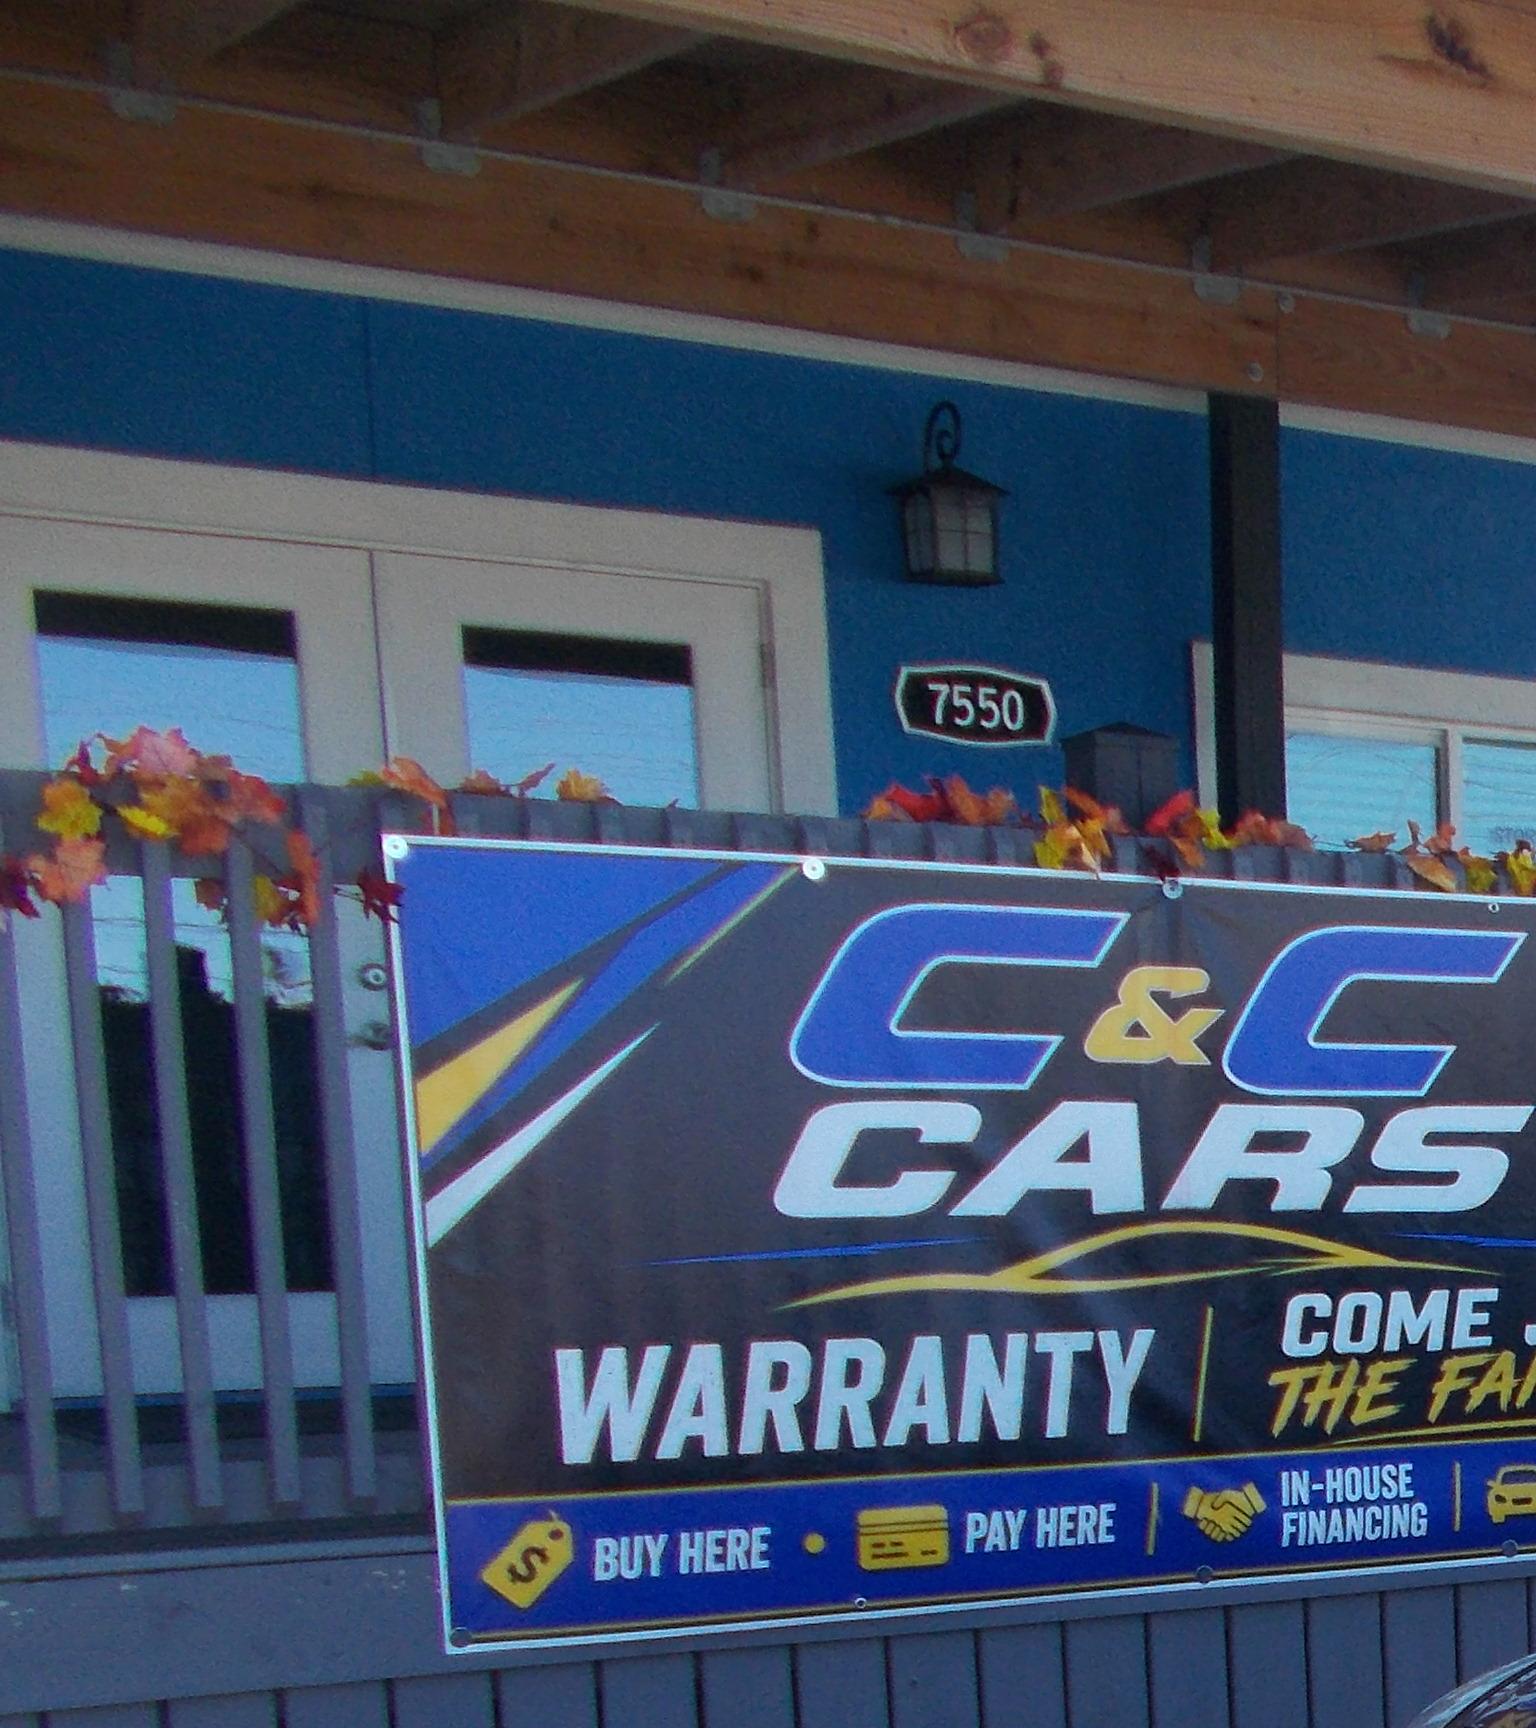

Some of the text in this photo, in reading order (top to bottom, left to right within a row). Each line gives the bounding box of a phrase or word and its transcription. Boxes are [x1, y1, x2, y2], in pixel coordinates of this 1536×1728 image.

[928, 683, 1024, 731] 7550
[773, 1101, 1536, 1218] CARS
[1281, 1288, 1500, 1358] COME
[555, 1328, 1155, 1465] WARRANTY
[1268, 1357, 1418, 1438] THE
[1281, 1463, 1414, 1507] IN-HOUSE
[965, 1503, 1117, 1553] PAY HERE
[1281, 1502, 1428, 1548] FINANCING
[594, 1526, 772, 1581] BUY HERE
